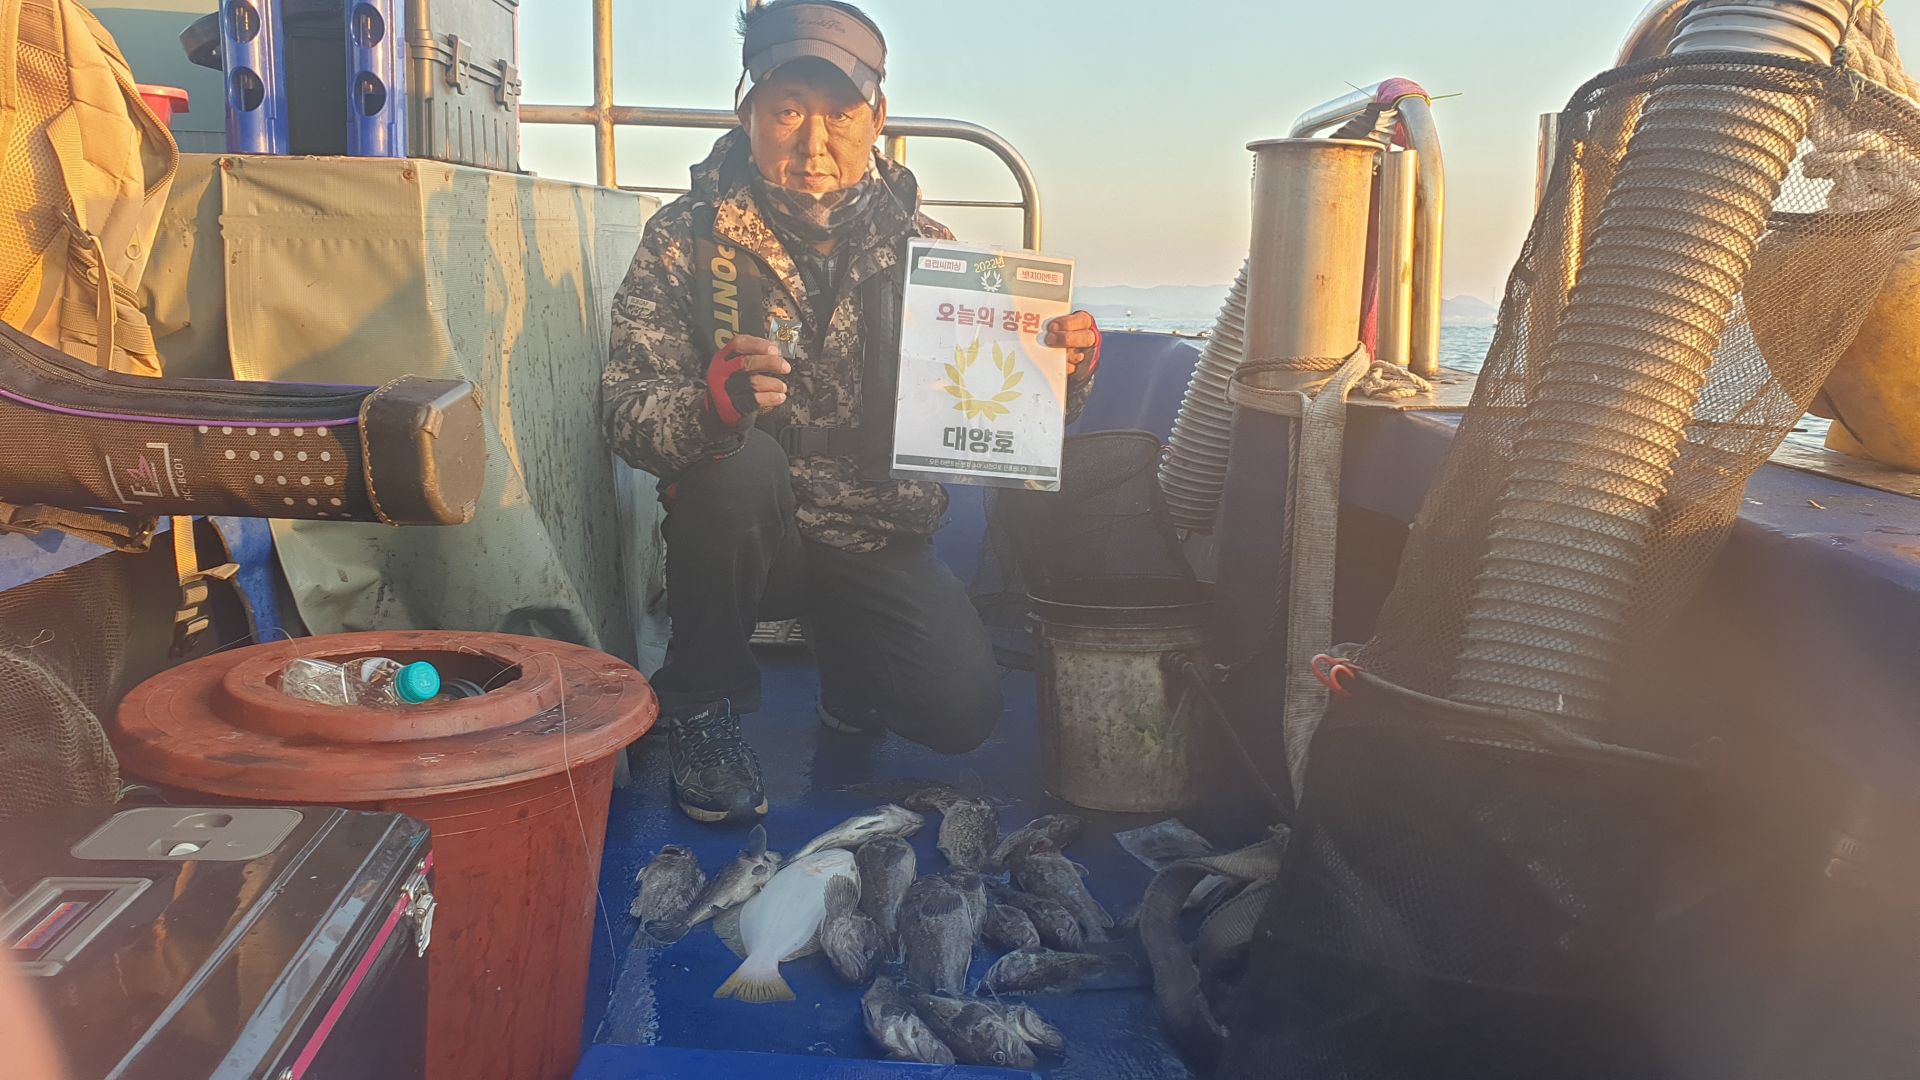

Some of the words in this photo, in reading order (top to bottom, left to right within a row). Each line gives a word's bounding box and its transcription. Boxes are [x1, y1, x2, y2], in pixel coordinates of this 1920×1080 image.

[973, 255, 1006, 273] 2022년
[936, 302, 995, 328] 오늘의
[1002, 310, 1041, 335] 장원
[943, 426, 1015, 454] 대양호
